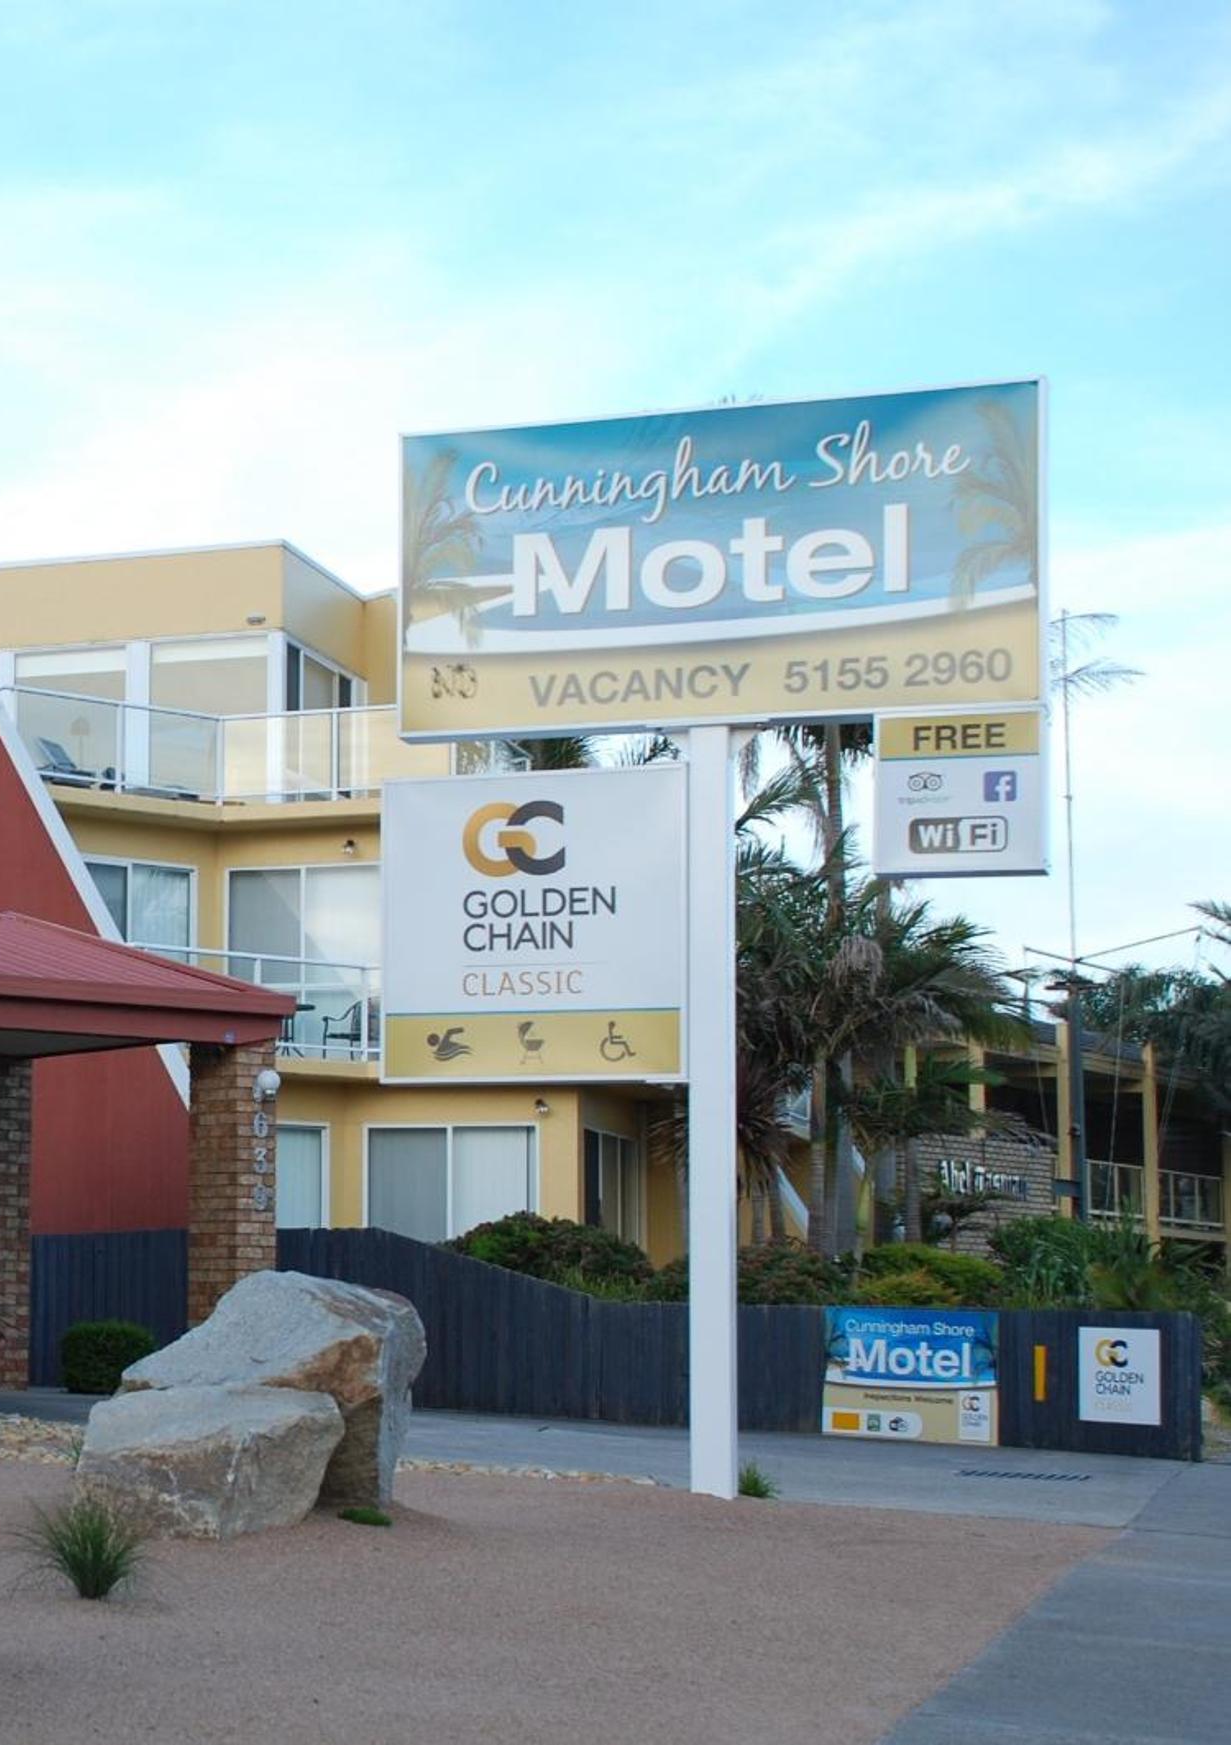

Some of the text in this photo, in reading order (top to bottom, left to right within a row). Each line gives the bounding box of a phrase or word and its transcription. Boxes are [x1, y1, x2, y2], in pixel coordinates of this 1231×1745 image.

[465, 420, 970, 523] Cunningham Shore
[512, 503, 910, 617] Motel
[529, 664, 752, 707] VACANCY
[784, 655, 889, 693] 5155
[903, 648, 1012, 686] 2960
[913, 723, 1006, 751] FREE
[463, 886, 616, 919] GOLDEN
[463, 920, 574, 953] CHAIN
[462, 969, 583, 997] CLASSIC
[845, 1319, 975, 1337] Cunningham Shore
[849, 1338, 972, 1379] Motel
[1095, 1370, 1145, 1385] GOLDEN
[1095, 1383, 1131, 1395] CHAIN
